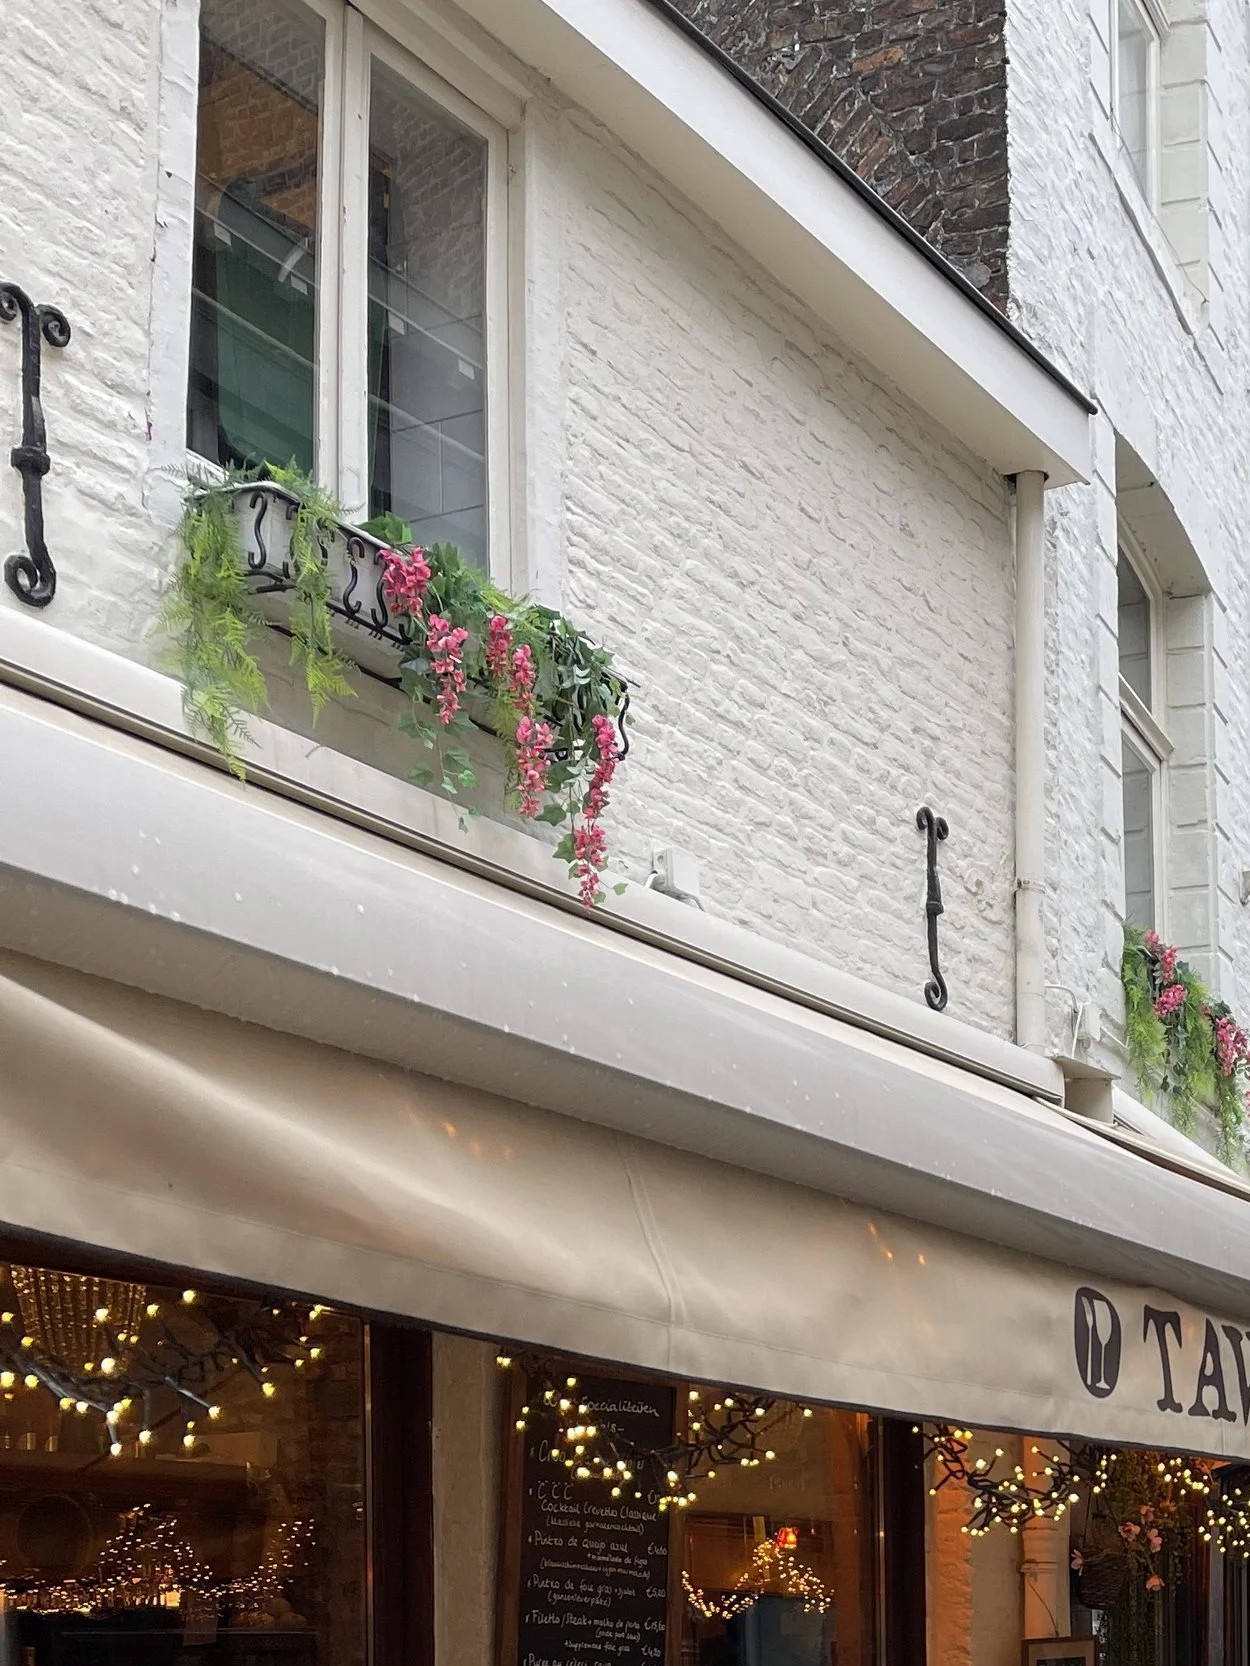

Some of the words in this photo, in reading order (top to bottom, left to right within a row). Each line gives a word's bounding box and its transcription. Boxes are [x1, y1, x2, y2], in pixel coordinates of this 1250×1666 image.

[541, 1500, 580, 1513] Cocktail
[568, 1535, 578, 1547] de
[565, 1578, 574, 1590] de
